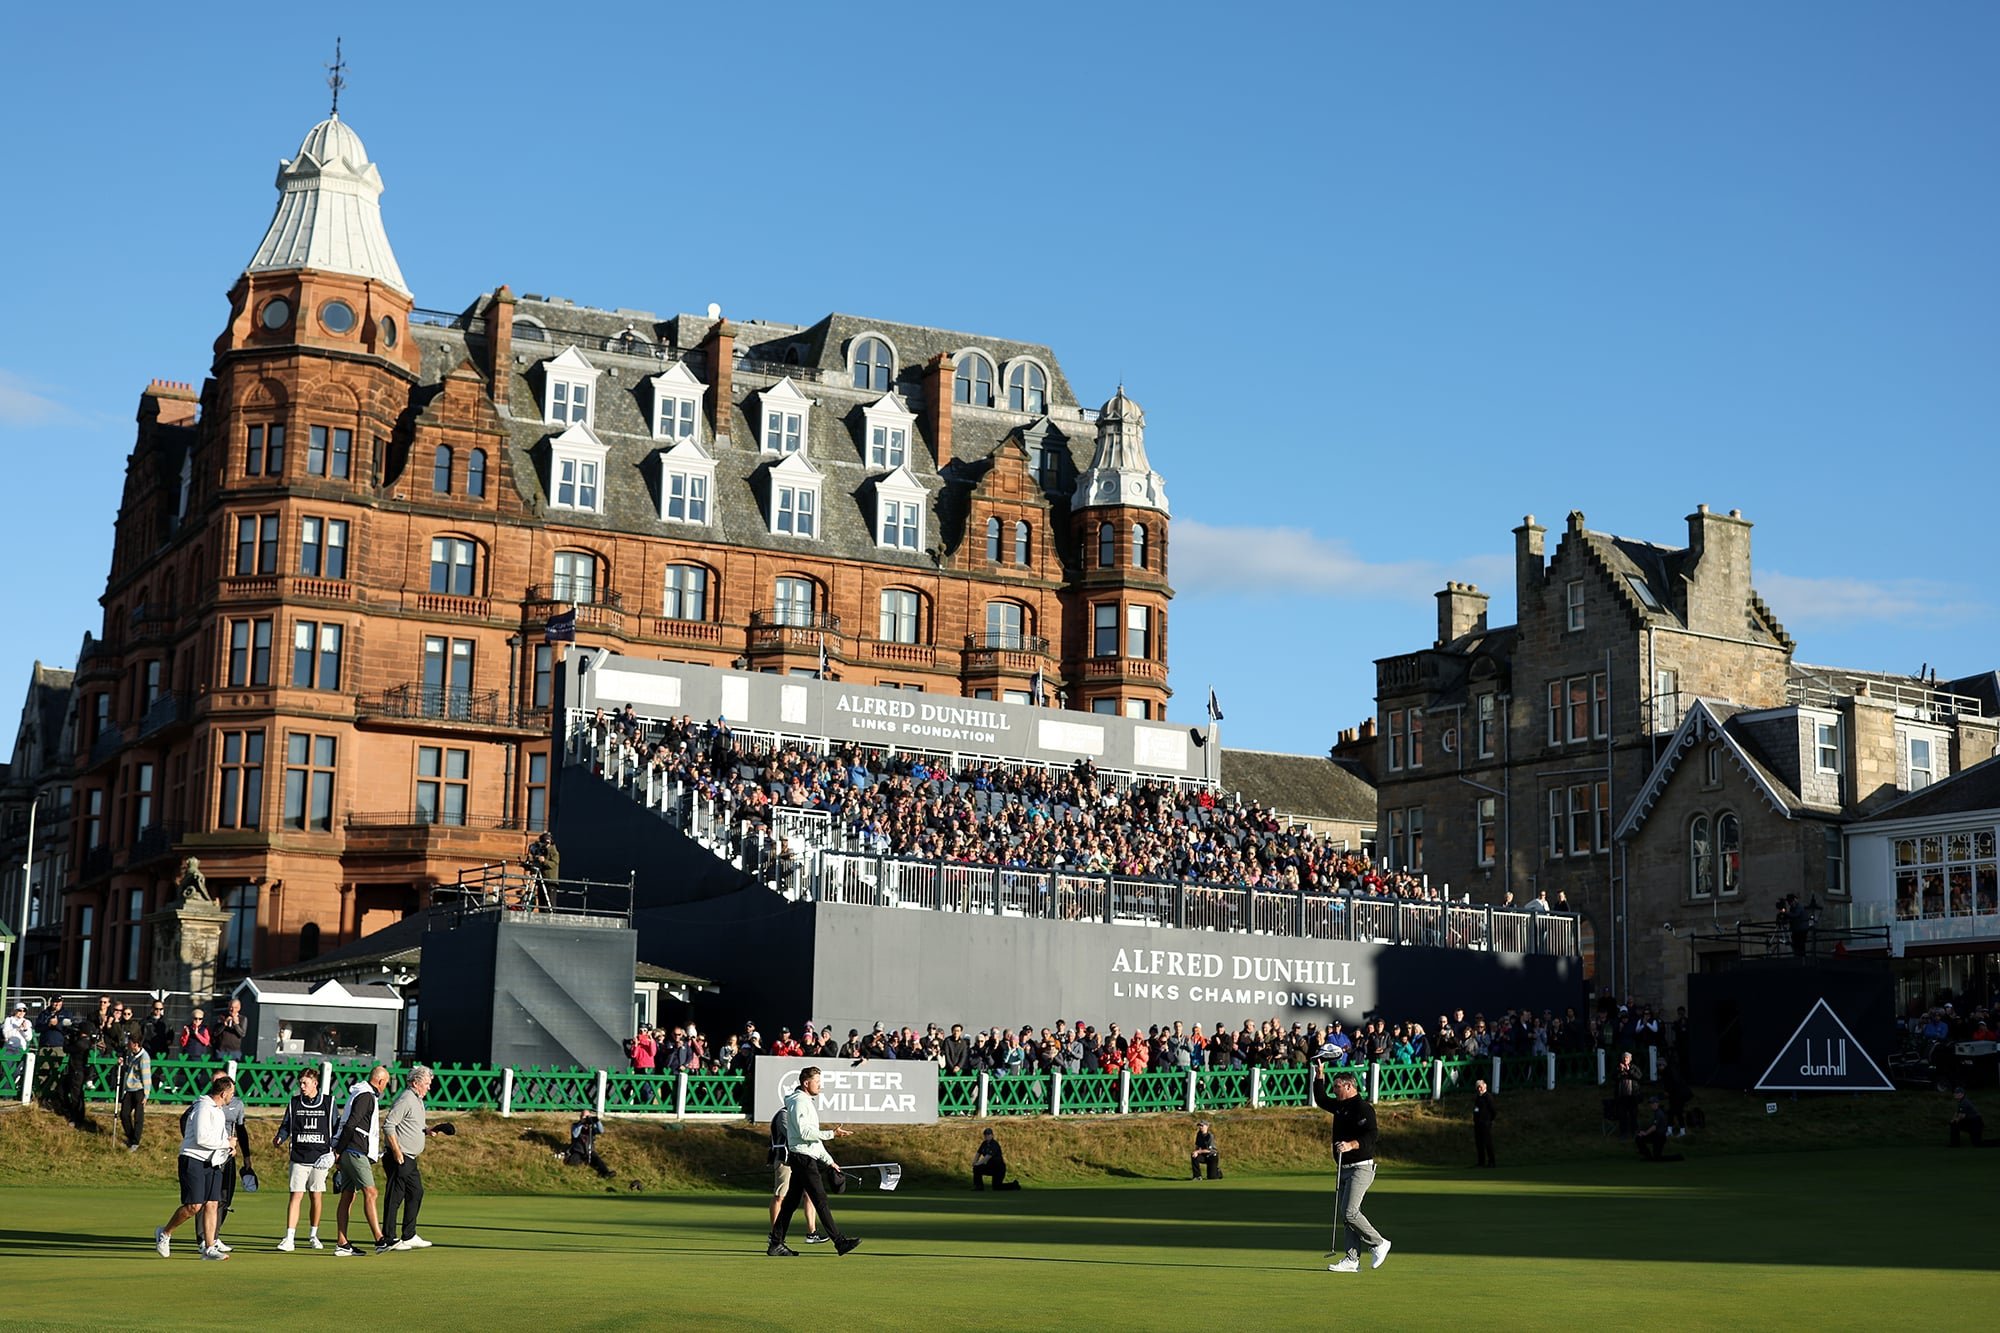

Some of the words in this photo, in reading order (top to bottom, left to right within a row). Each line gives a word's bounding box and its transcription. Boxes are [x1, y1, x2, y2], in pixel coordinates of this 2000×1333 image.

[836, 694, 915, 719] ALFRED
[921, 703, 1011, 731] DUNHILL
[852, 717, 897, 732] LINKS
[902, 723, 995, 743] FOUNDATION
[1111, 948, 1223, 978] ALFRED
[1232, 955, 1356, 986] DUNHILL
[1113, 982, 1180, 1000] LINKS
[1189, 986, 1354, 1009] CHAMPIONSHIP
[1800, 1038, 1847, 1076] dunhill
[820, 1070, 903, 1090] PETER
[818, 1093, 916, 1112] MILLAR
[297, 1134, 325, 1144] MANSELL
